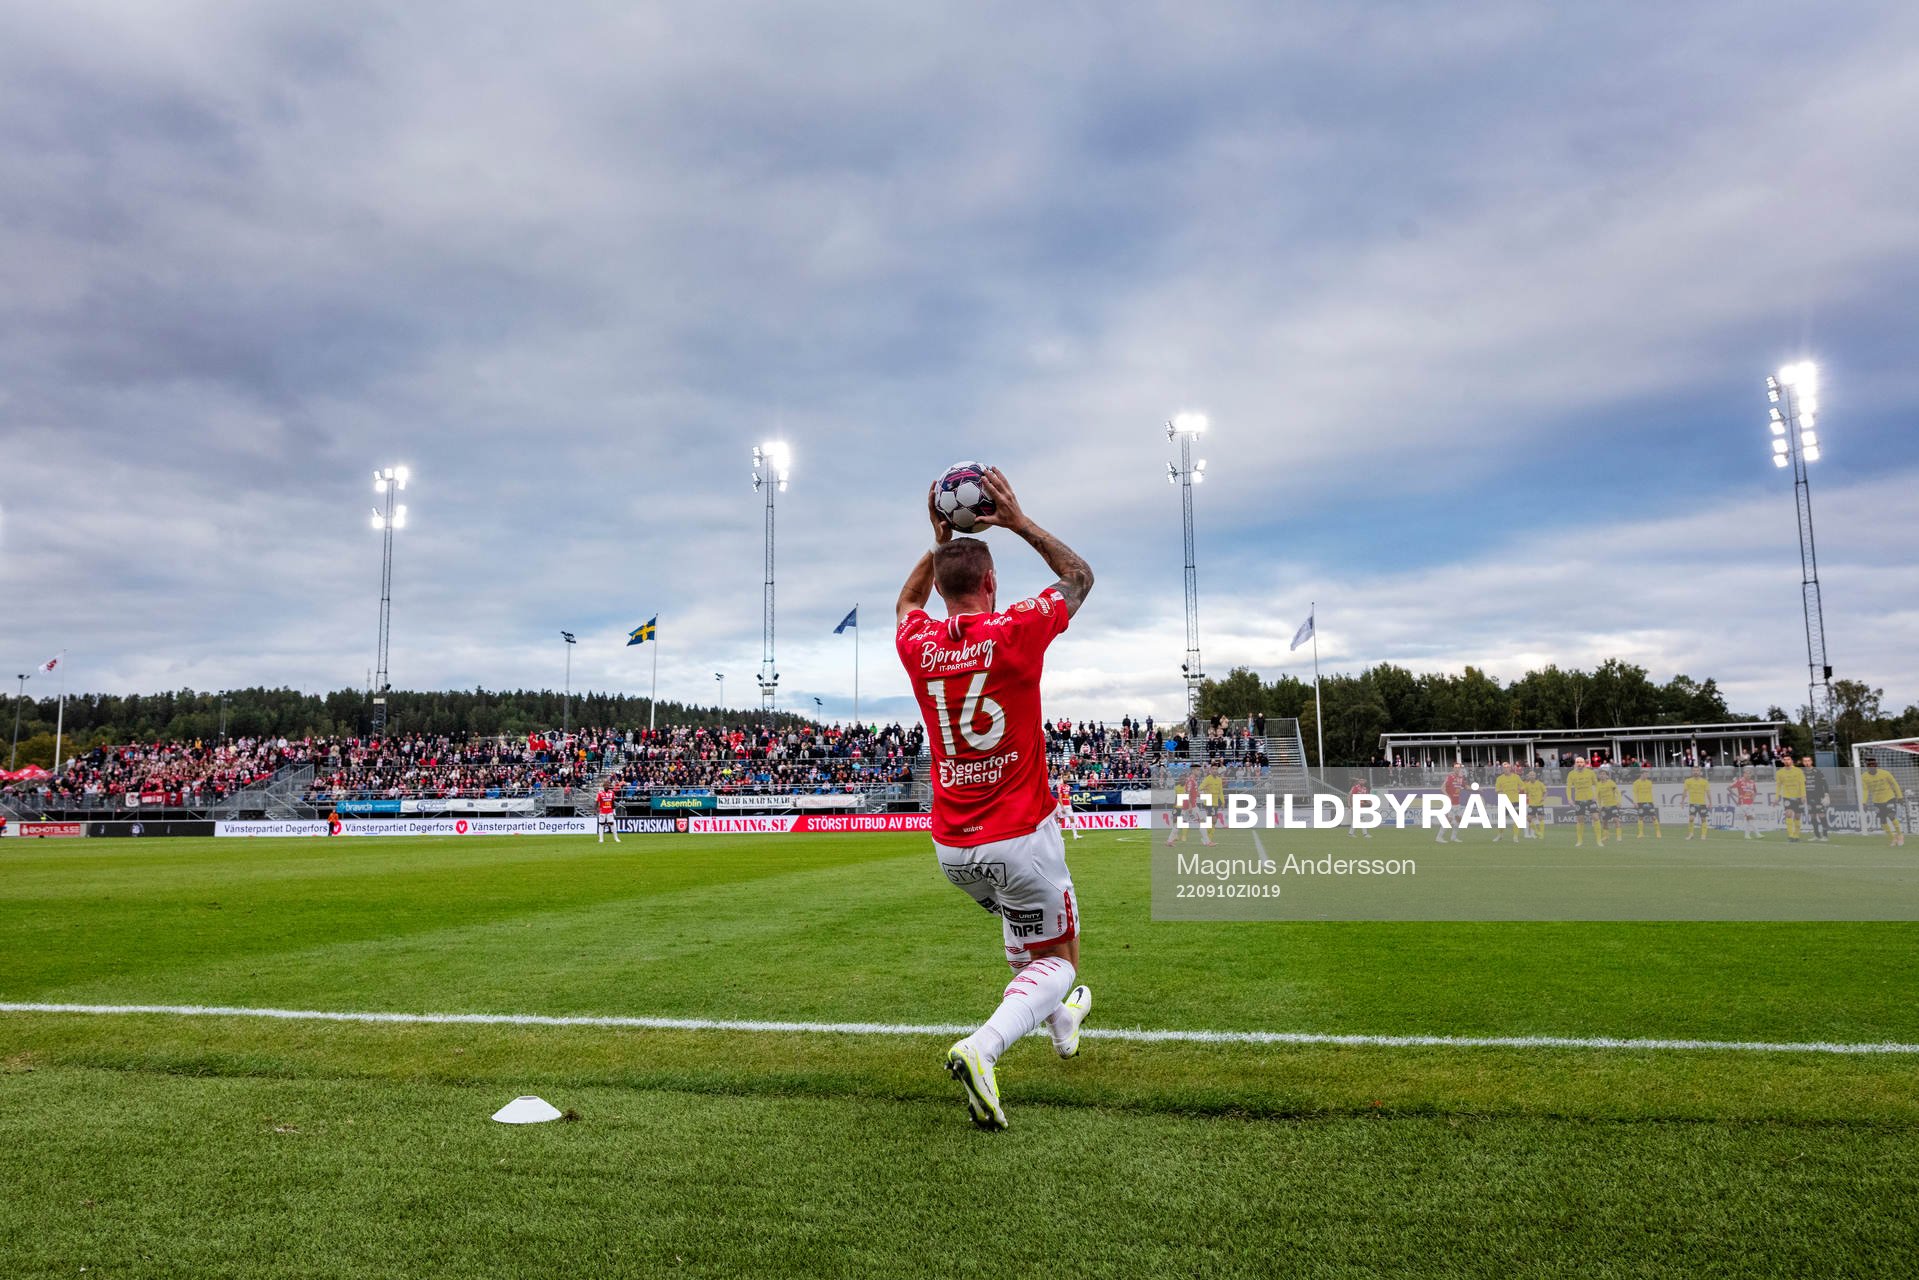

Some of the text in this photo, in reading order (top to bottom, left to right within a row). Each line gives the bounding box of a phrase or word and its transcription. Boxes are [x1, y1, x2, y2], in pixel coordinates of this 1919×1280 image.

[920, 638, 997, 672] Björnberg
[939, 660, 978, 672] IT-PARTNER
[927, 672, 1006, 756] 16
[956, 765, 1002, 786] Energi
[660, 799, 702, 808] Assemblin
[224, 823, 328, 836] Vänsterpartiet Degerfors
[345, 822, 454, 835] Vänsterpartiet Degerfors
[472, 820, 586, 834] Vänsterpartiet Degerfors
[693, 817, 788, 832] STÄLLNING.SE
[807, 816, 849, 830] STÖRST
[851, 817, 887, 829] UTBUD
[888, 817, 903, 829] AV
